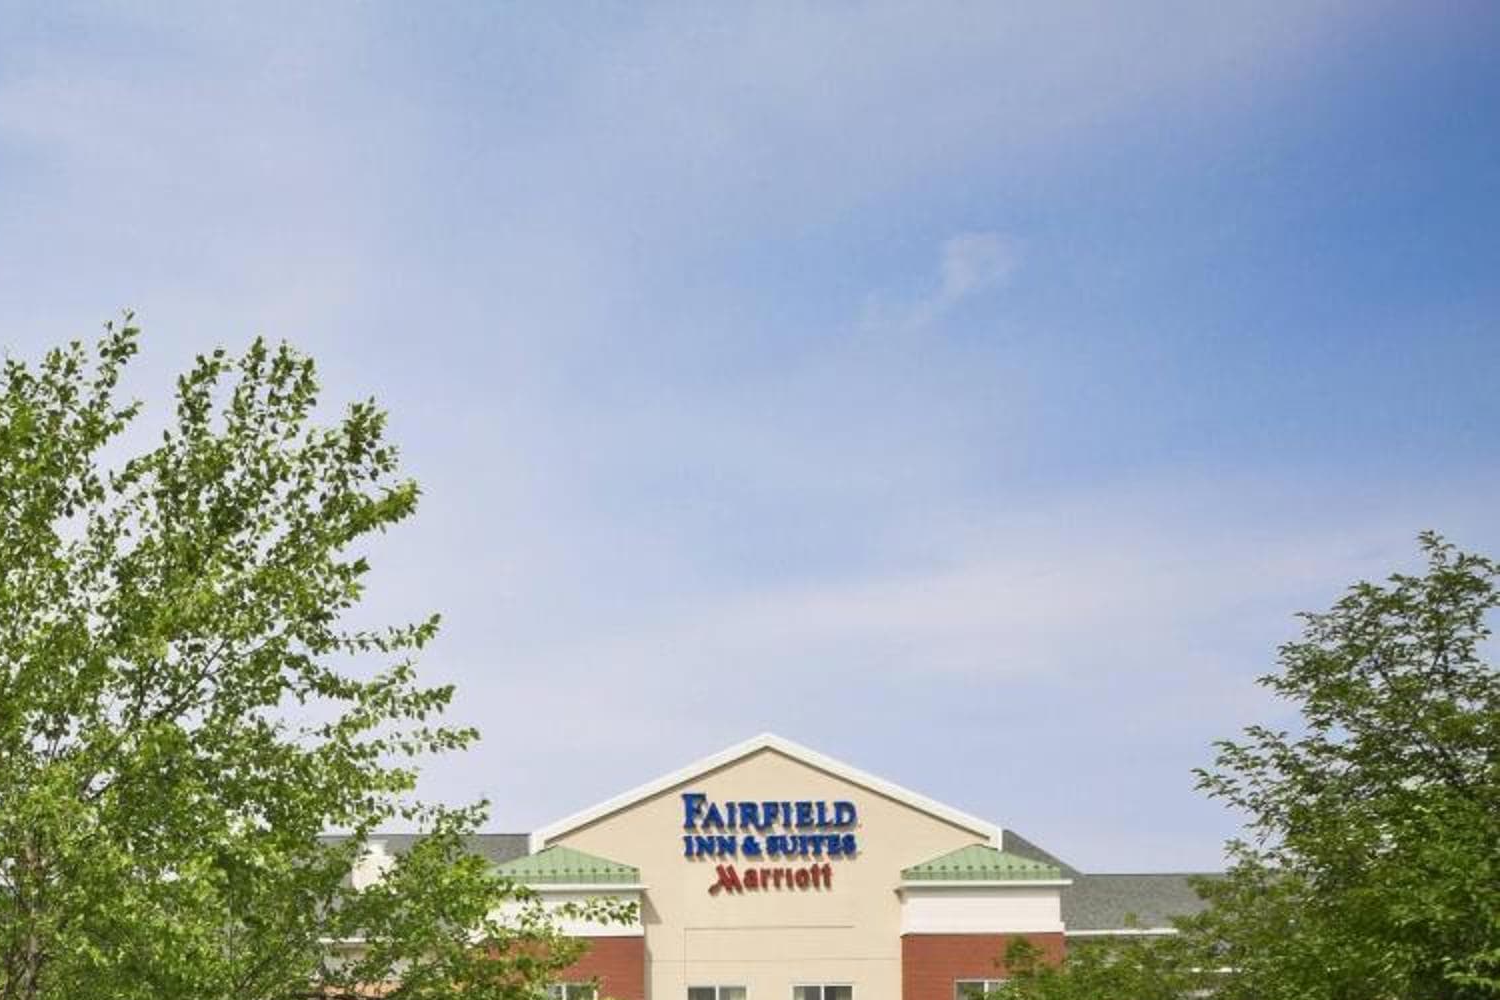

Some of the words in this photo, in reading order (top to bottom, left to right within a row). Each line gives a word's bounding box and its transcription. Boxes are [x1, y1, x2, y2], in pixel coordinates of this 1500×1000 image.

[681, 793, 858, 831] FAIRFIELD
[683, 835, 738, 857] INN
[741, 835, 762, 857] &
[765, 834, 858, 857] SUITES
[708, 863, 833, 895] Marriott
